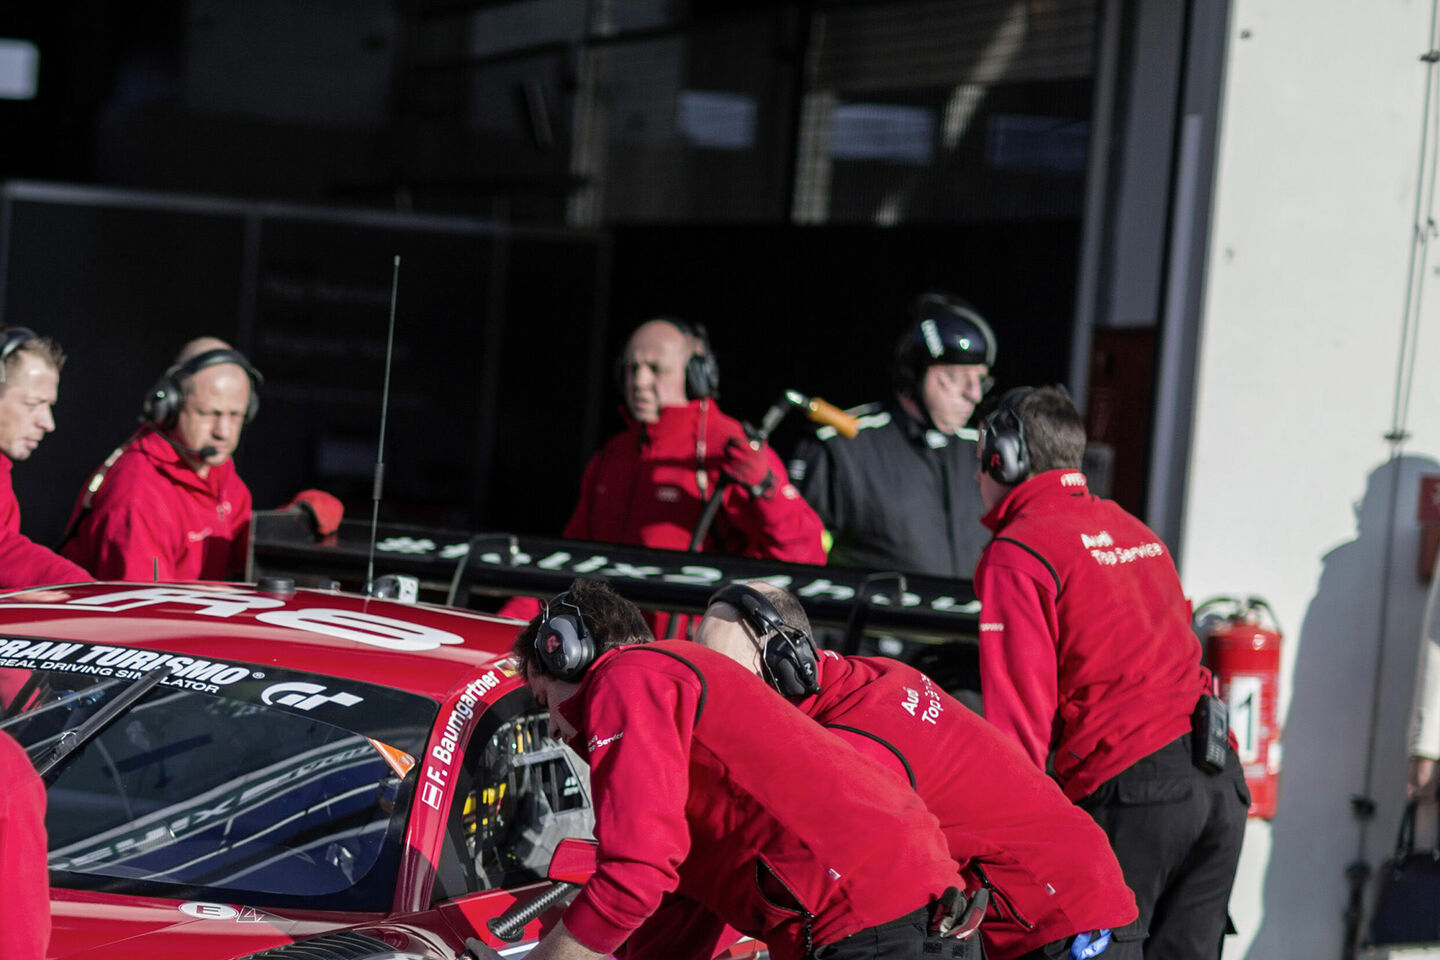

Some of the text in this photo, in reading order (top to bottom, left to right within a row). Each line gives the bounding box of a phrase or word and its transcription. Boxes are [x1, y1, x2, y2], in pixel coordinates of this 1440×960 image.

[1080, 531, 1113, 549] Audi
[1091, 543, 1163, 566] Top Service
[40, 660, 114, 677] DRIVING
[114, 669, 220, 694] SILATOR
[75, 644, 251, 686] TURISMO
[427, 670, 500, 787] F. Baumgartner
[922, 700, 944, 725] Top
[1237, 692, 1254, 751] 1
